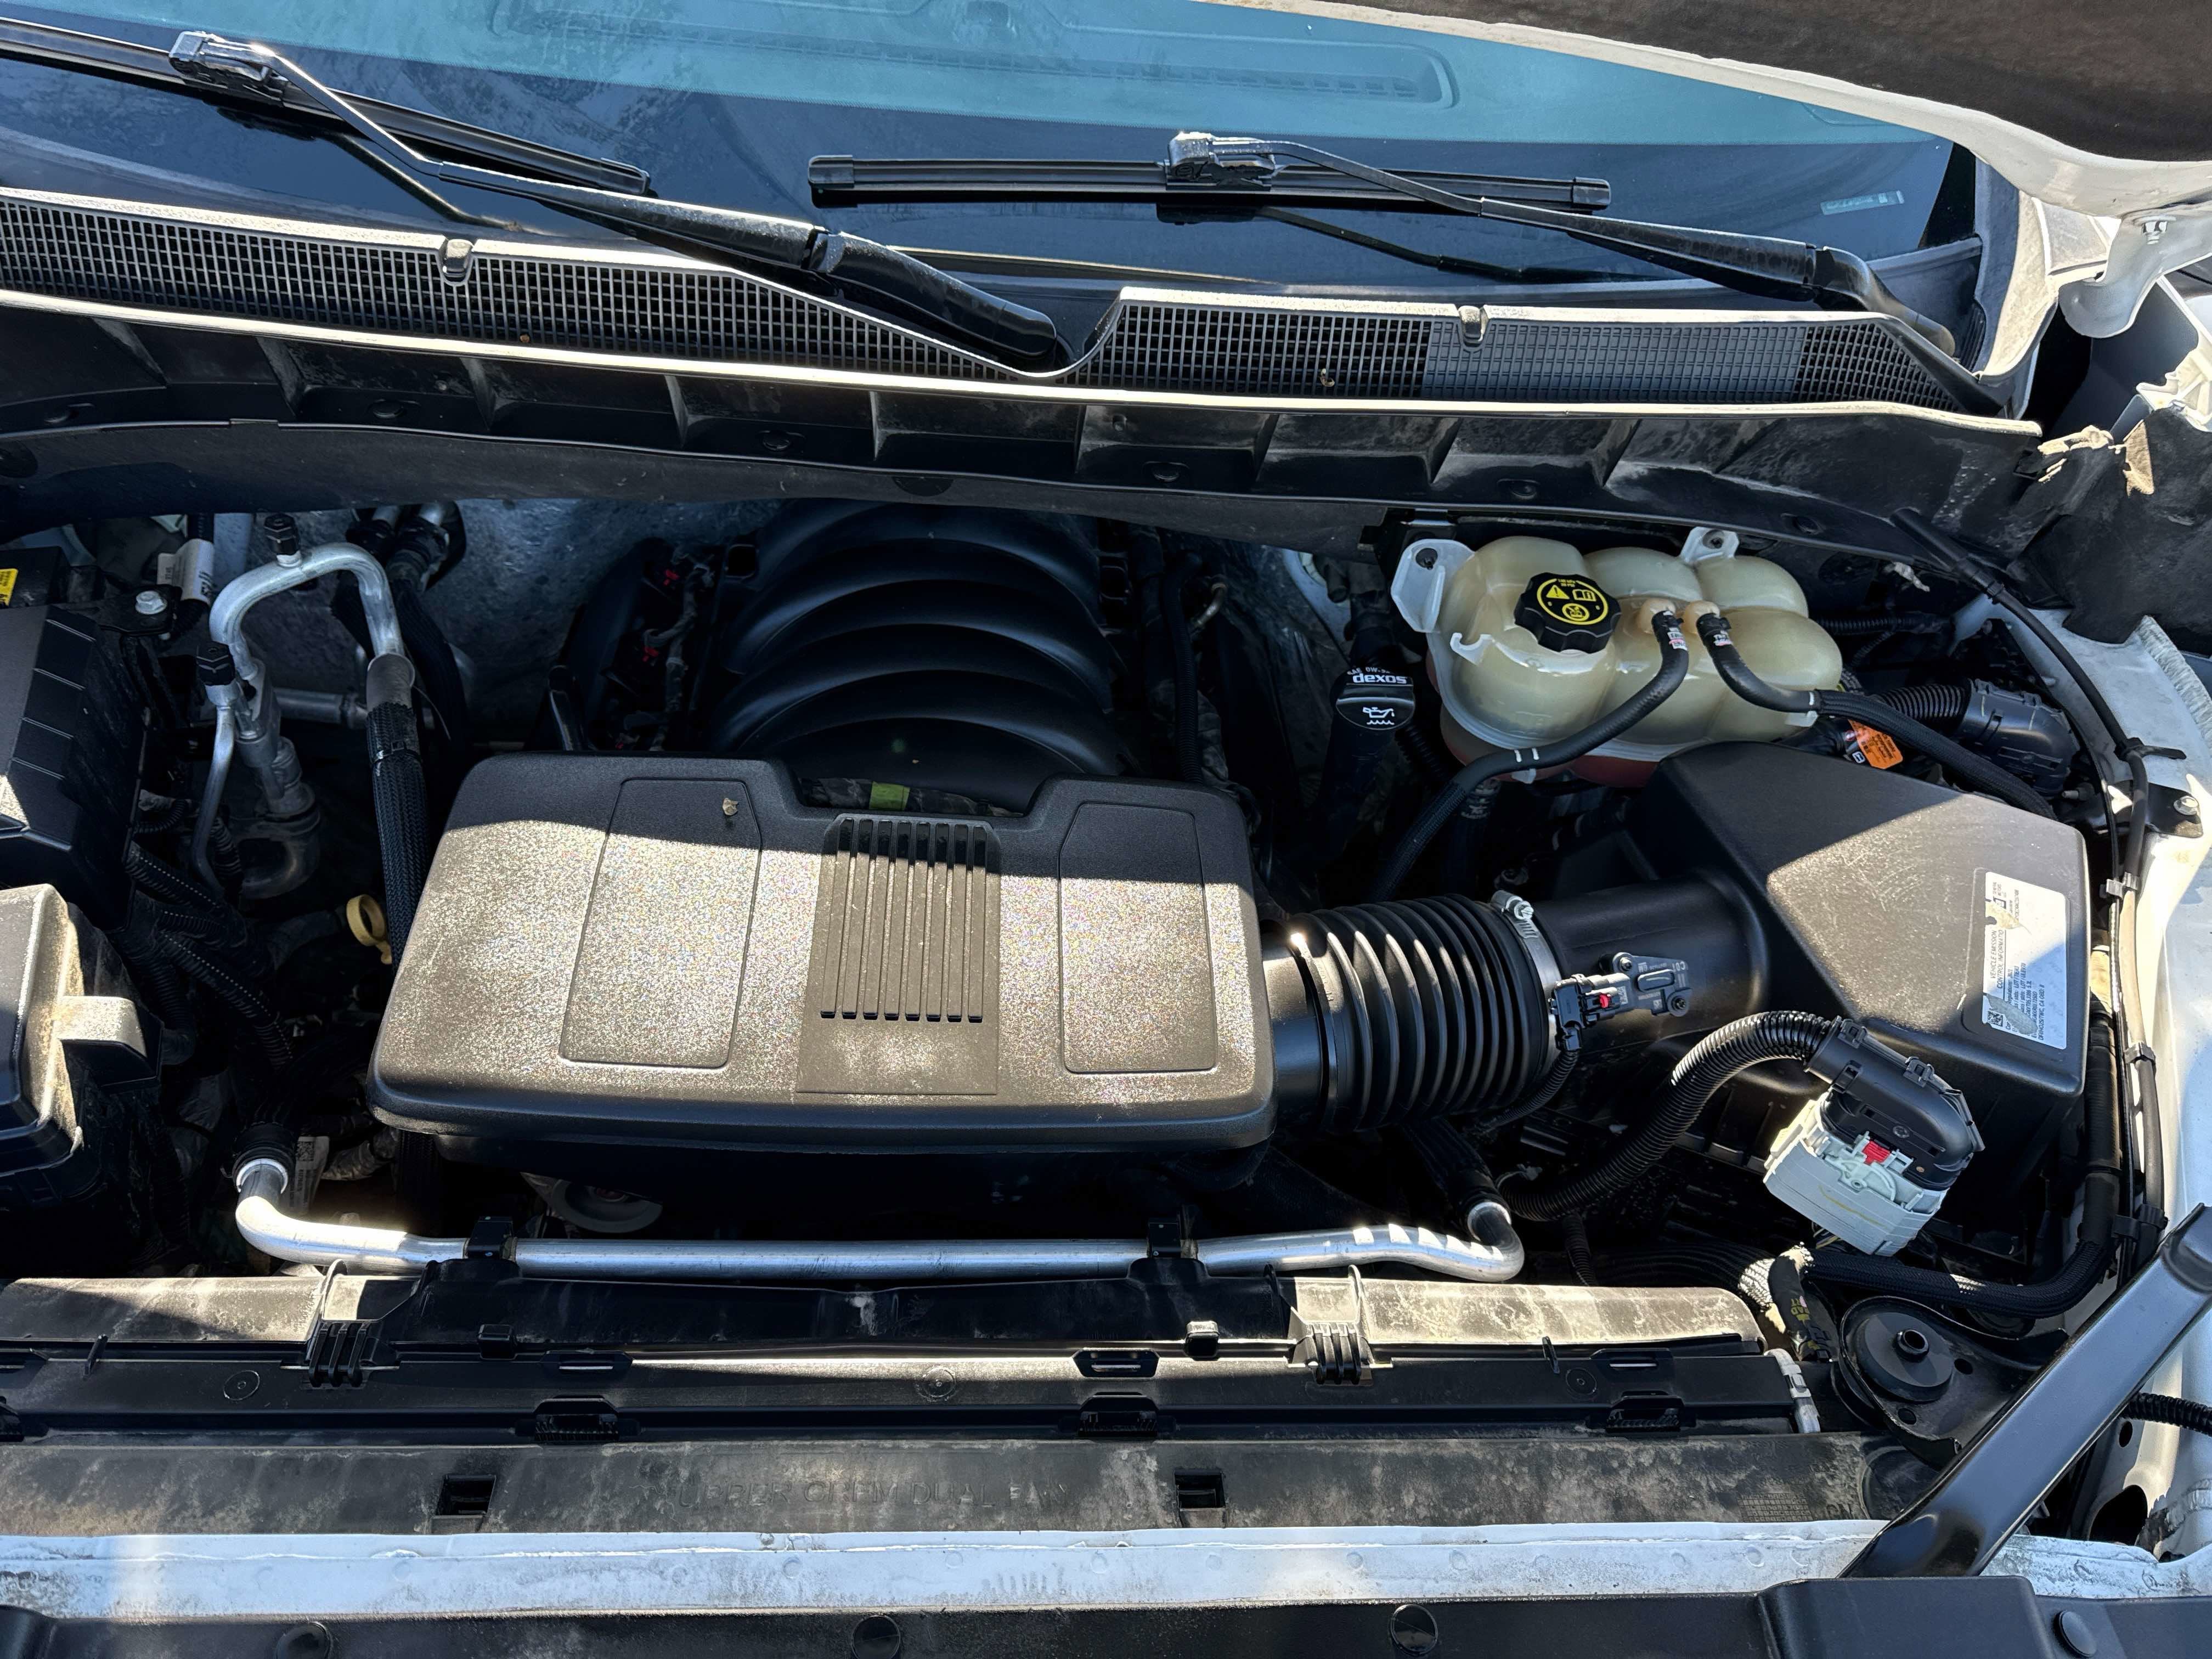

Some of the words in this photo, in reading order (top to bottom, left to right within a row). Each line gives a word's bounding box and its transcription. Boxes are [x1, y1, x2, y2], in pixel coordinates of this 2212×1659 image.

[1352, 673, 1407, 684] dexos
[676, 1482, 792, 1508] UPPER
[911, 1482, 996, 1508] DUAL
